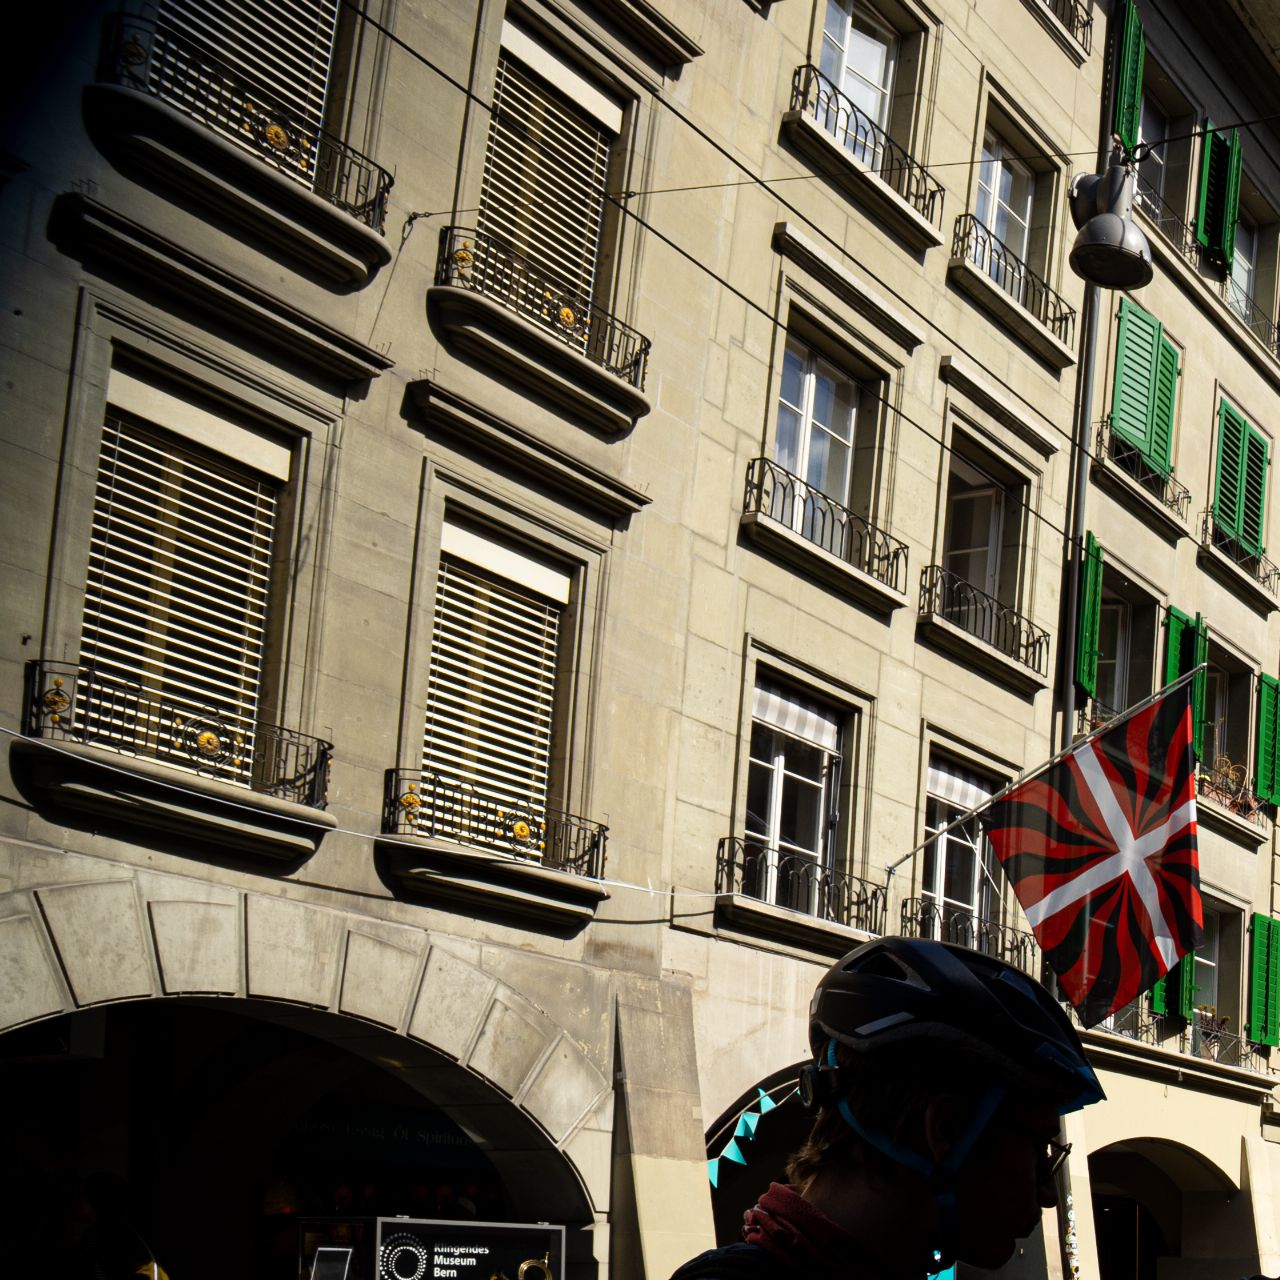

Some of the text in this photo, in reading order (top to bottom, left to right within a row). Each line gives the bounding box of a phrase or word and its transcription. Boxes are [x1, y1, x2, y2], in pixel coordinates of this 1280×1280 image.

[434, 1242, 490, 1256] Klingendes
[434, 1255, 477, 1266] Museum
[434, 1267, 457, 1278] Bern
